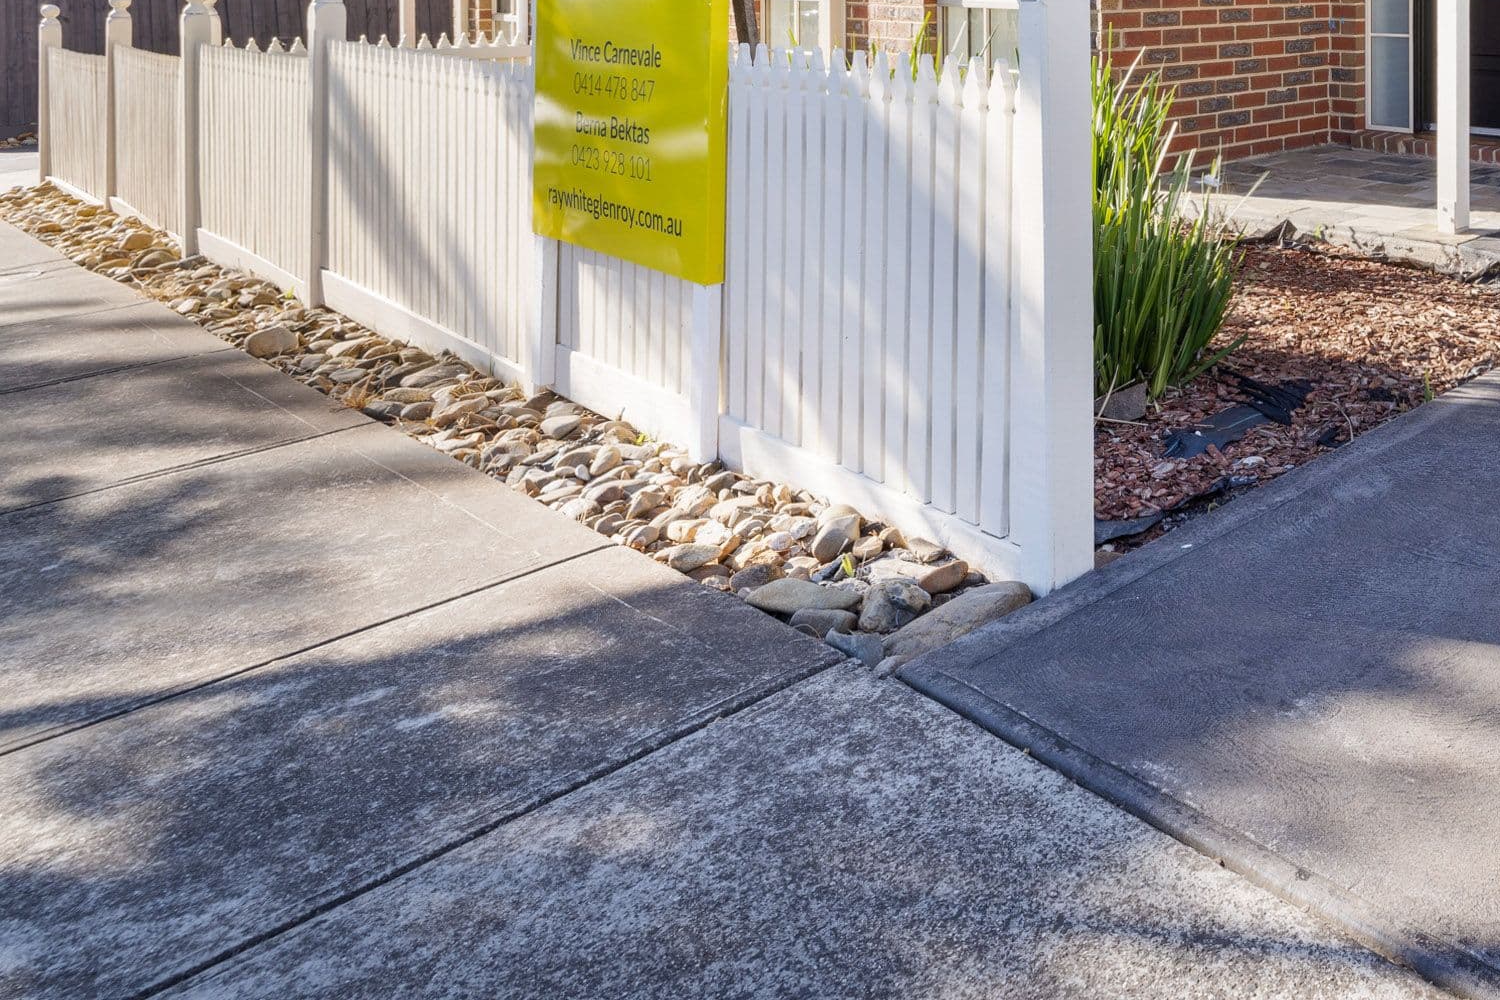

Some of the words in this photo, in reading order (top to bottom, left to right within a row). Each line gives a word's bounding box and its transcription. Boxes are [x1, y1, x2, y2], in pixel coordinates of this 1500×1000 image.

[571, 38, 601, 61] Vince
[603, 41, 662, 69] Carnevale
[573, 72, 602, 96] 0414
[605, 76, 628, 100] 478
[630, 79, 655, 103] 847
[575, 111, 607, 138] Berna
[610, 116, 650, 144] Bektas
[571, 144, 600, 171] 0423
[604, 151, 625, 176] 928
[629, 155, 652, 182] 101
[548, 185, 683, 237] raywhiteglenroy.com.au
